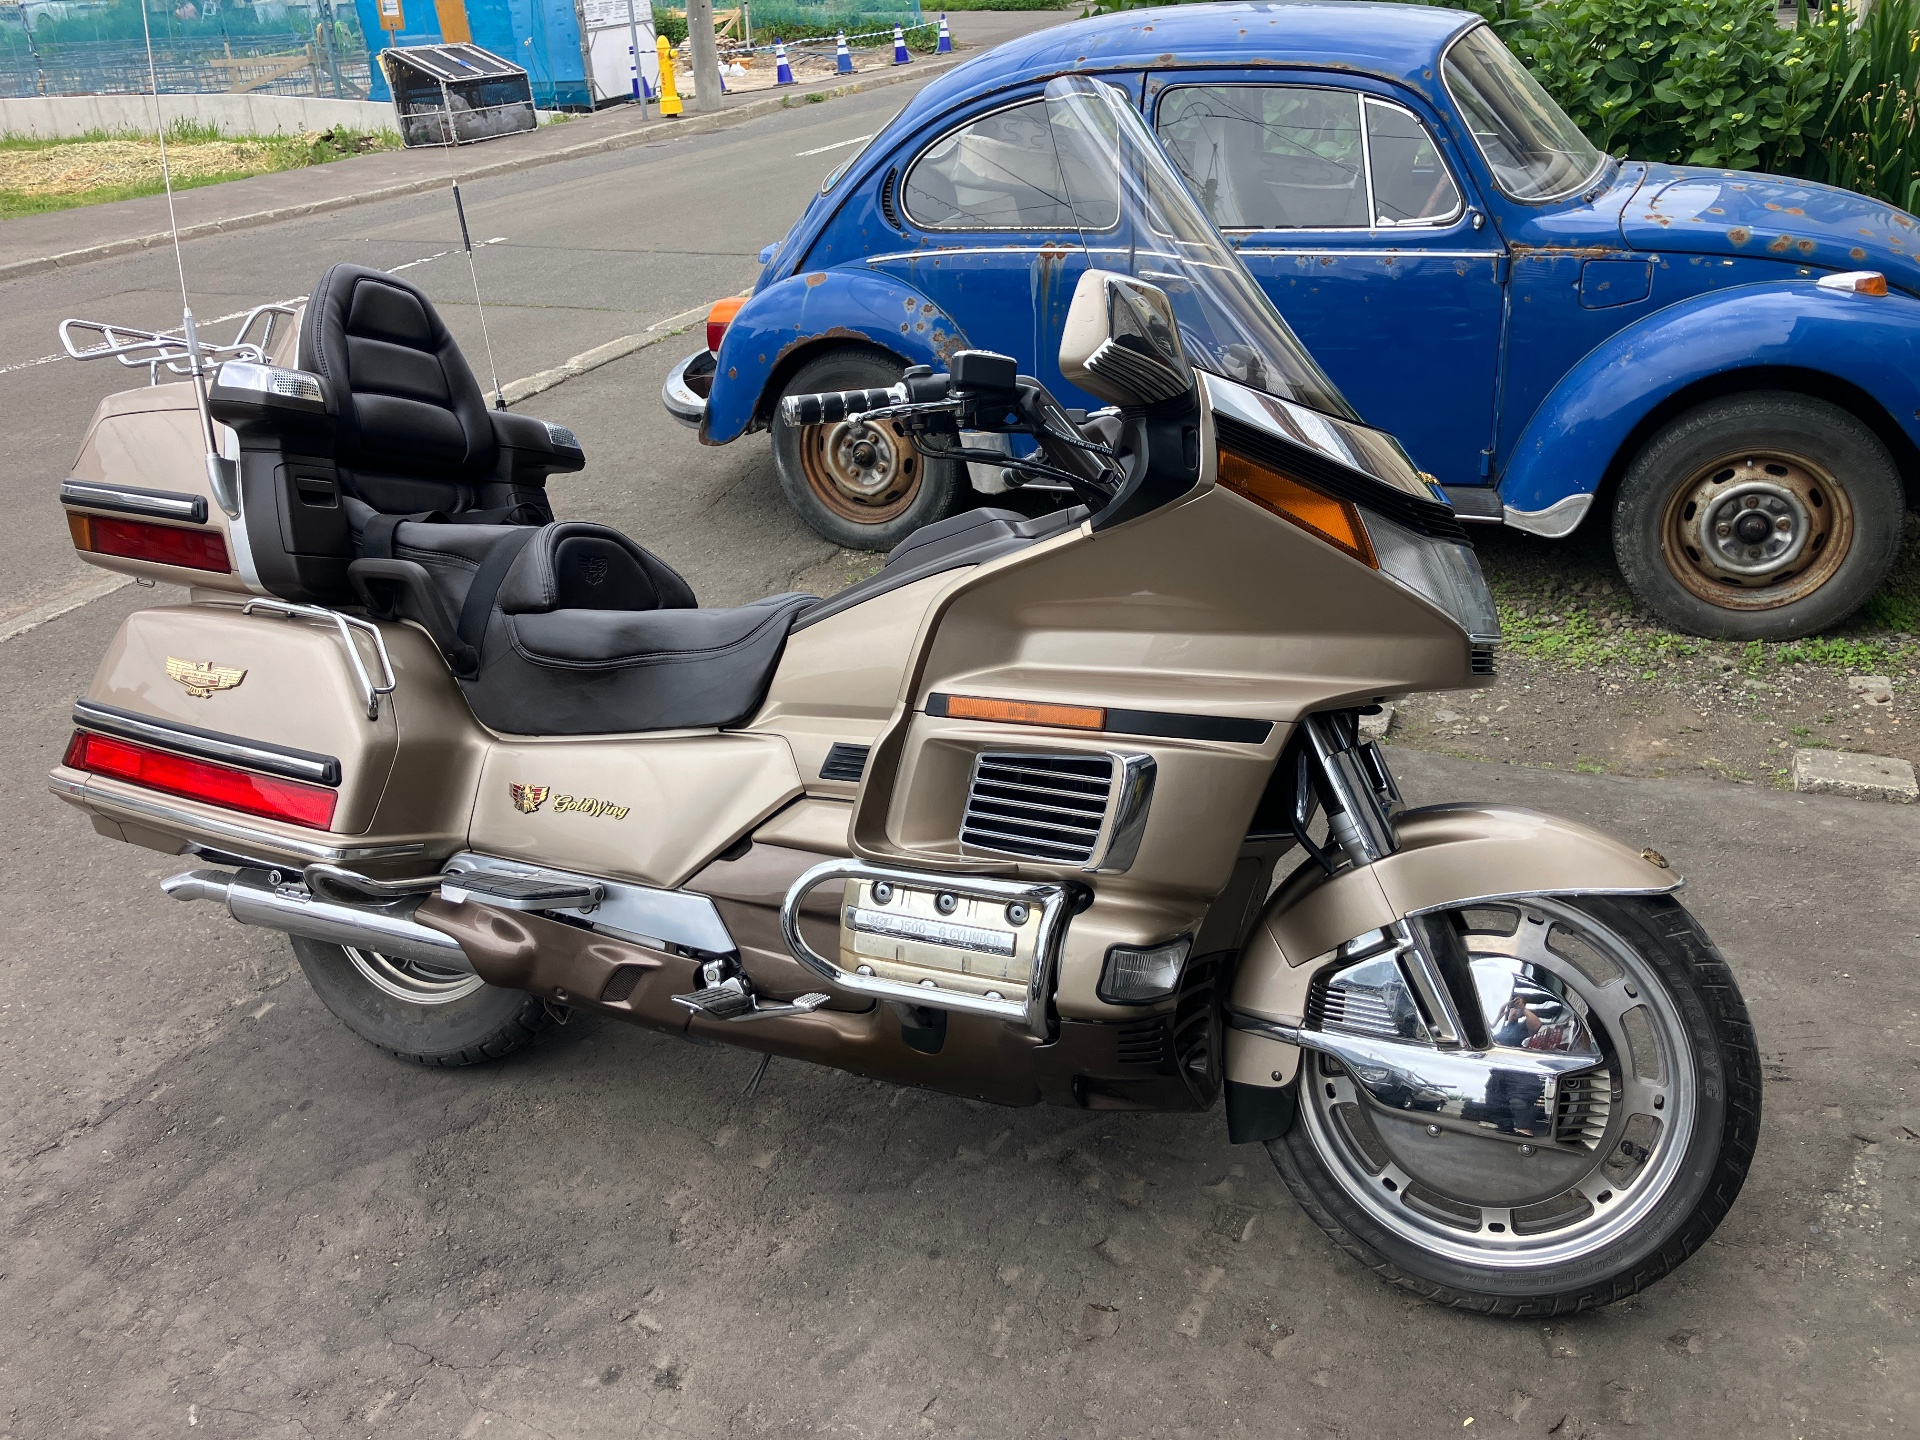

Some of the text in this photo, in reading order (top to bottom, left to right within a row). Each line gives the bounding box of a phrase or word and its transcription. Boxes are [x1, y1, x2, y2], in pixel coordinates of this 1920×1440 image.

[551, 793, 631, 820] GoldWing
[899, 919, 1002, 946] 1500 6 CYLINDER
